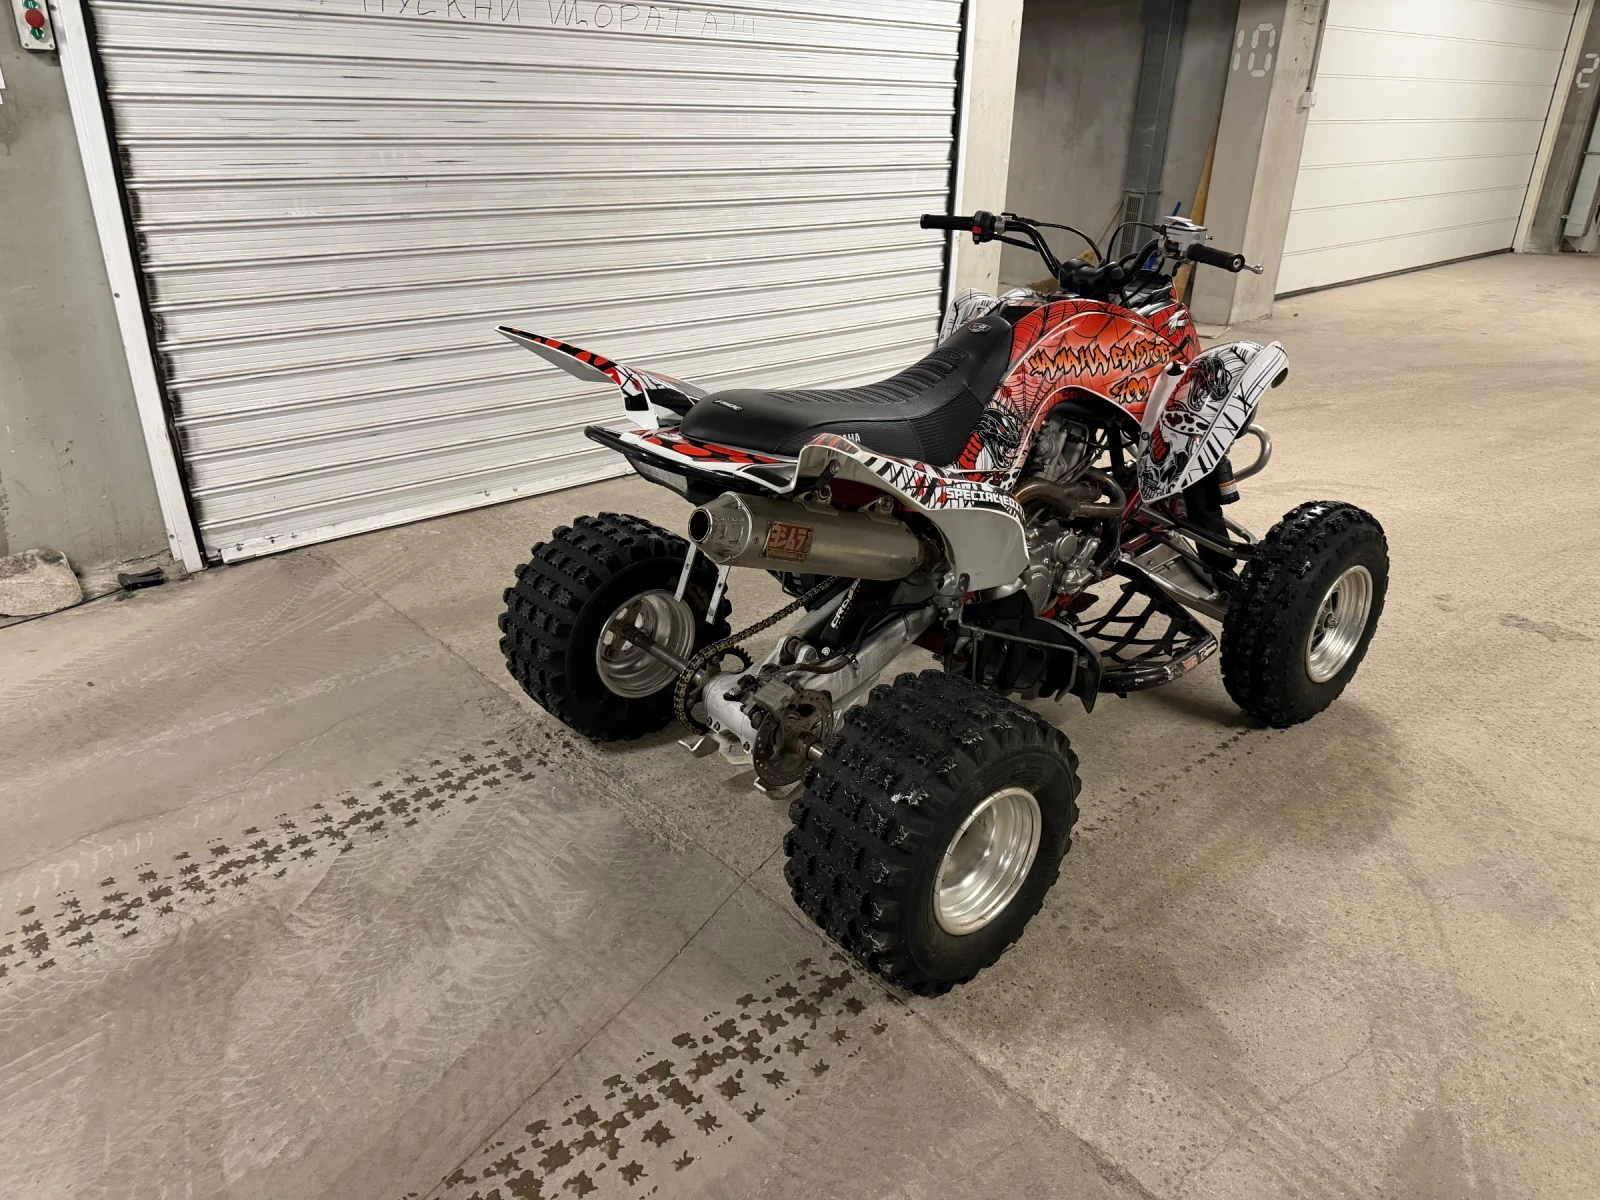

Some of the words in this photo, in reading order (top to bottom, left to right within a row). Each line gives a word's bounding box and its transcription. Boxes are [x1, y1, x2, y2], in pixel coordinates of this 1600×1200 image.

[1233, 23, 1276, 77] 10
[1576, 53, 1600, 88] 2
[1028, 344, 1110, 380] YAMAHA
[1109, 338, 1171, 372] RAPTOR
[1109, 376, 1149, 404] 700
[945, 487, 1000, 503] SPECIAL
[768, 524, 808, 551] ヨシムラ
